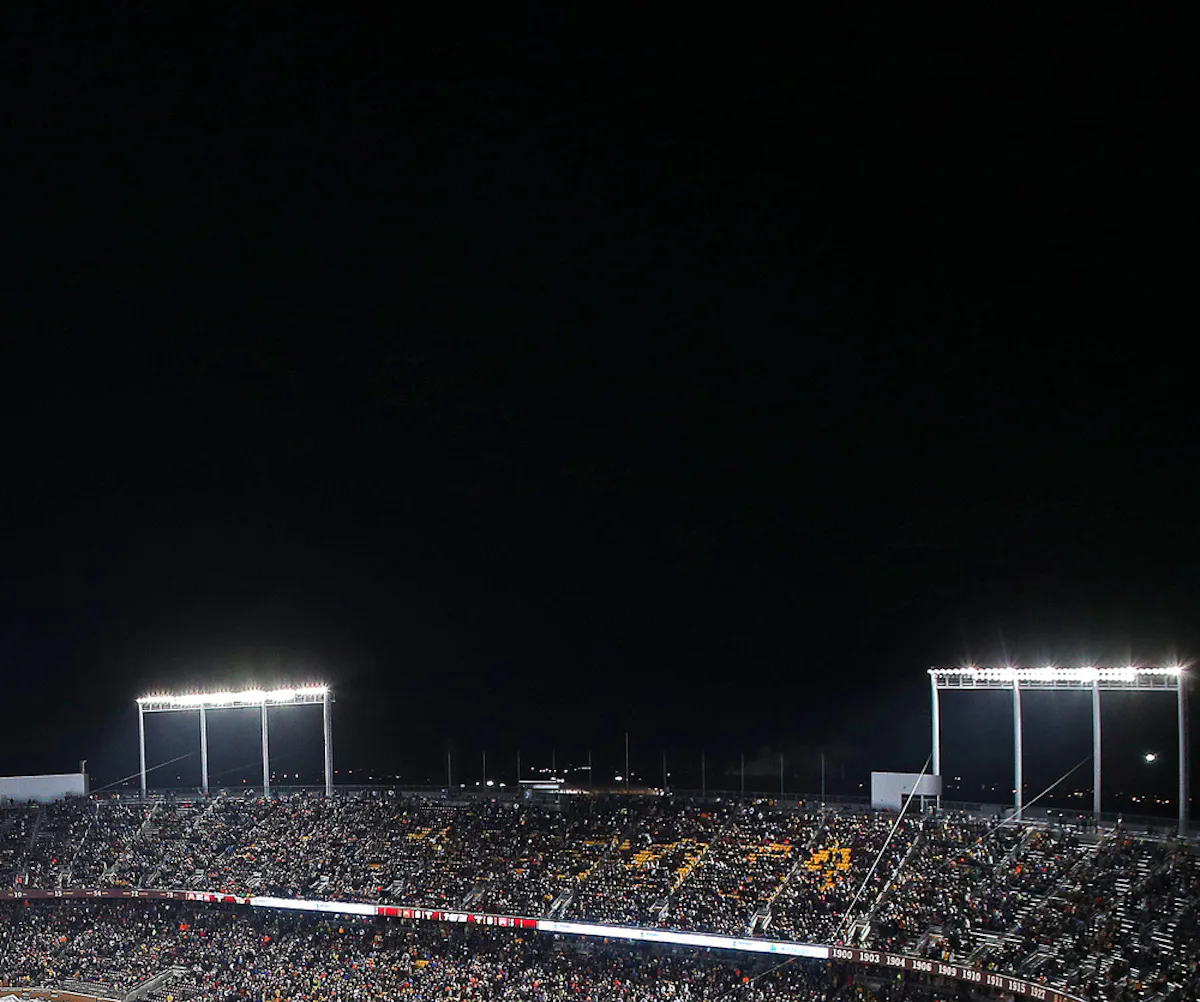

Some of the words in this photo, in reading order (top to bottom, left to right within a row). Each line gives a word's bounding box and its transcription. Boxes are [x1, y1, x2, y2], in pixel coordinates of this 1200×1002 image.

[832, 948, 853, 960] 1900
[859, 951, 880, 963] 1903
[886, 955, 905, 968] 1904
[912, 960, 932, 972] 1906
[938, 964, 957, 977] 1909
[962, 969, 982, 982] 1910
[987, 974, 1003, 987] 1911
[1008, 980, 1026, 994] 1915
